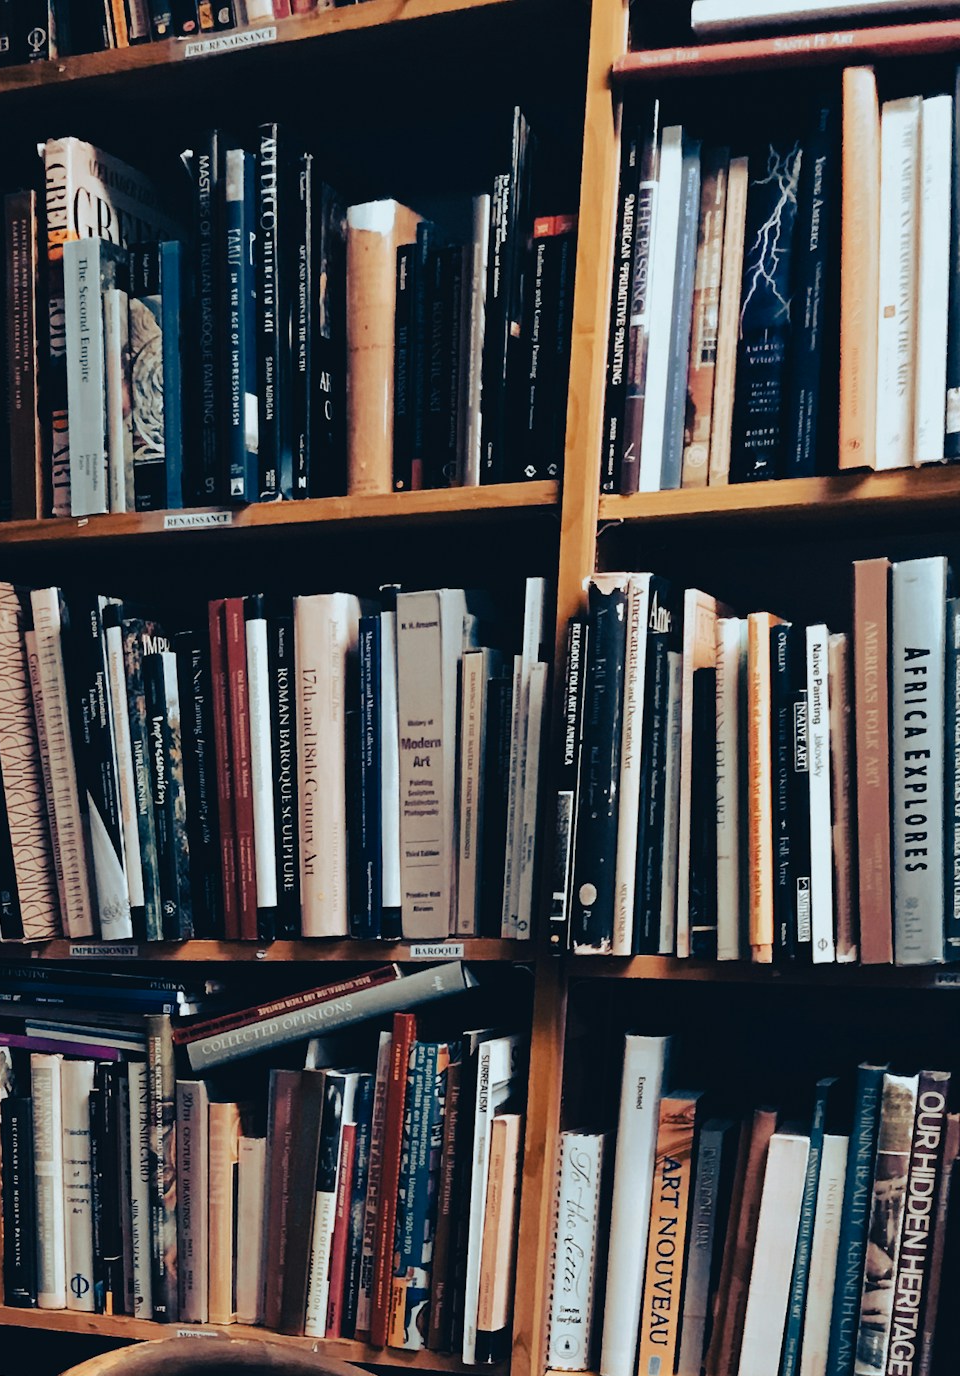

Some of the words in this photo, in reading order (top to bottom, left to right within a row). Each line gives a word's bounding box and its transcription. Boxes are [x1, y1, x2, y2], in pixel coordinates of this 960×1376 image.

[621, 194, 634, 258] AMERICAN
[78, 258, 88, 282] The
[231, 272, 238, 284] IN
[79, 286, 90, 331] Second
[616, 262, 629, 326] PRIMITIVE
[231, 311, 239, 329] AGE
[231, 333, 239, 344] OF
[79, 336, 91, 382] Empire
[612, 328, 625, 384] PAINTING
[232, 350, 240, 425] IMPRESSIONISM
[167, 515, 230, 527] RENAISSANCE
[570, 624, 581, 669] RELIGIOUS
[628, 586, 644, 664] Americana:
[569, 671, 580, 693] FOLK
[627, 665, 637, 685] Folk
[812, 644, 822, 676] Naive
[277, 668, 290, 724] ROMAN
[303, 669, 317, 704] 17th
[568, 695, 578, 712] ART
[627, 686, 635, 704] and
[812, 680, 823, 724] Painting
[904, 648, 931, 739] AFRICA
[304, 711, 317, 736] and
[567, 714, 576, 723] IN
[624, 706, 636, 751] Decorative
[152, 716, 168, 805] Impressionism
[304, 742, 318, 773] 18th
[401, 738, 441, 748] Modern
[412, 757, 432, 767] Art
[565, 726, 575, 764] AMERICA
[625, 755, 634, 769] Art
[813, 733, 824, 777] Jakovsky
[278, 729, 293, 804] BAROQUE
[302, 779, 318, 844] Century
[904, 750, 930, 872] EXPLORES
[281, 807, 294, 891] SCULPTURE
[304, 849, 317, 875] Art
[72, 947, 136, 956] IMPRESSIONIST
[413, 946, 460, 955] BAROQUE
[200, 1020, 274, 1052] COLLECTED
[276, 999, 344, 1027] OPINIONS
[428, 1047, 435, 1055] El
[414, 1076, 422, 1108] artistas
[480, 1055, 488, 1113] SURREALISM
[636, 1077, 645, 1109] Exposed
[183, 1092, 193, 1121] 20TH
[413, 1110, 420, 1121] en
[856, 1088, 876, 1161] FEMININE
[915, 1091, 946, 1148] OUR
[183, 1127, 191, 1172] CENTURY
[412, 1123, 420, 1136] los
[419, 1095, 431, 1168] latinoamericano:
[156, 1119, 165, 1199] TOULOUSE-LAUTREC
[410, 1140, 419, 1173] Estados
[568, 1148, 591, 1187] To
[182, 1179, 191, 1229] DRAWINGS
[661, 1156, 682, 1208] ART
[852, 1166, 871, 1226] BEAUTY
[902, 1151, 939, 1248] HIDDEN
[566, 1191, 586, 1229] the
[563, 1234, 584, 1293] Letter
[650, 1217, 678, 1345] NOUVEAU
[841, 1241, 863, 1315] KENNETH
[887, 1254, 926, 1376] HERITAGE
[836, 1318, 857, 1372] CLARK
